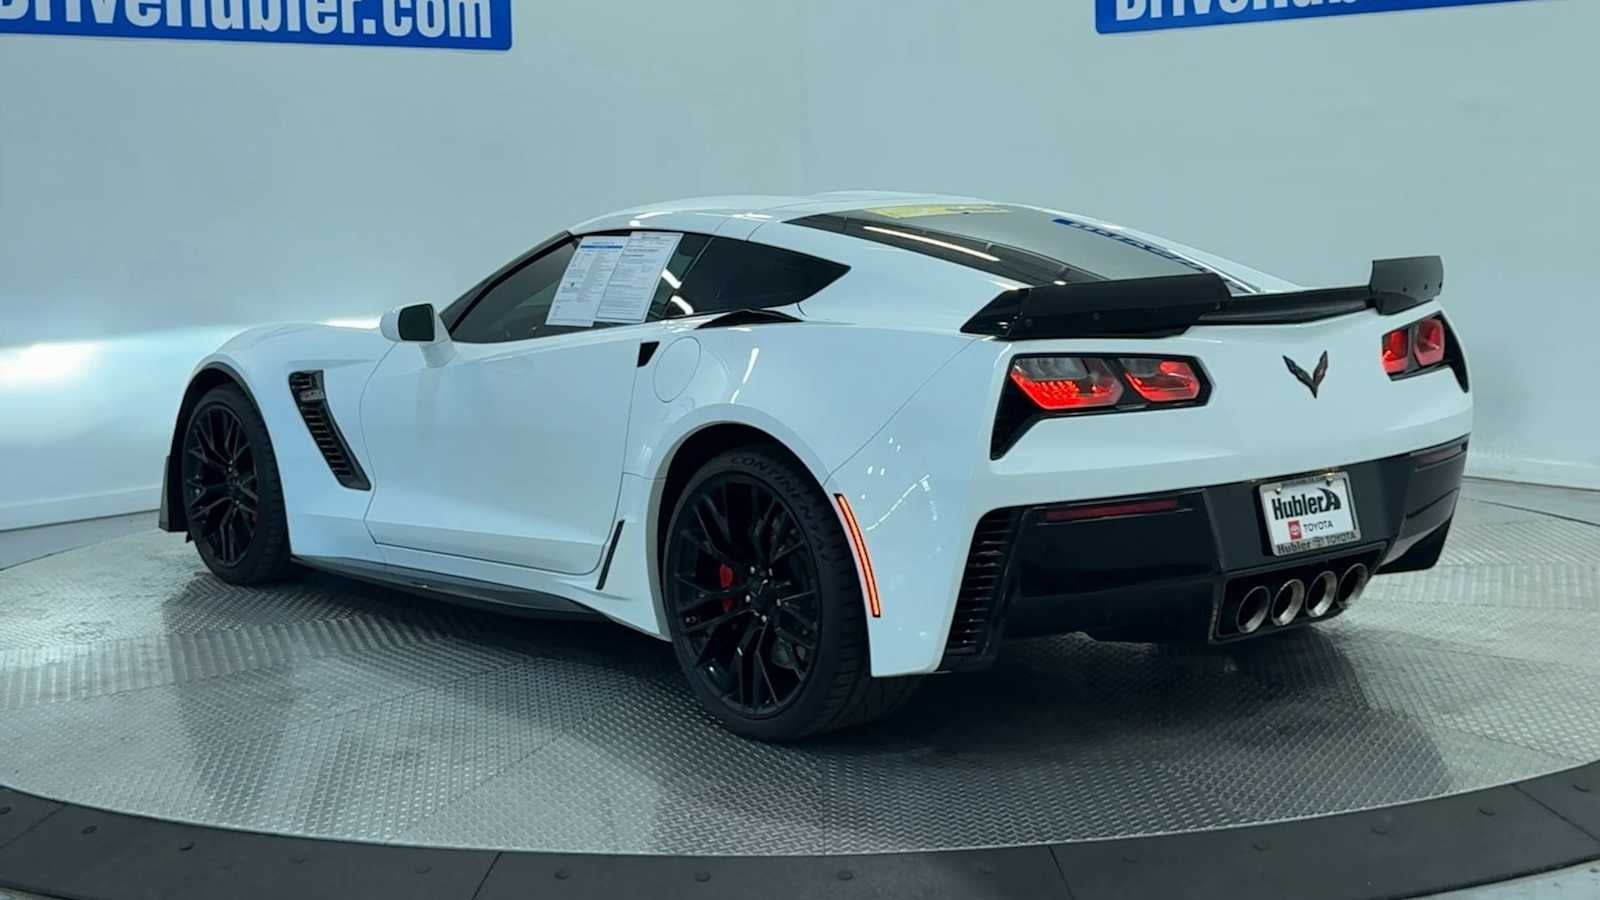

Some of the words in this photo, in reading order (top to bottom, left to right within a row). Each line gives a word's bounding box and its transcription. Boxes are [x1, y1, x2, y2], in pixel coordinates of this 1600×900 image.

[1271, 494, 1324, 520] Hubler
[1303, 520, 1334, 532] TOYOTA
[1276, 541, 1311, 554] Hubler
[1325, 531, 1356, 545] TOYOTA
